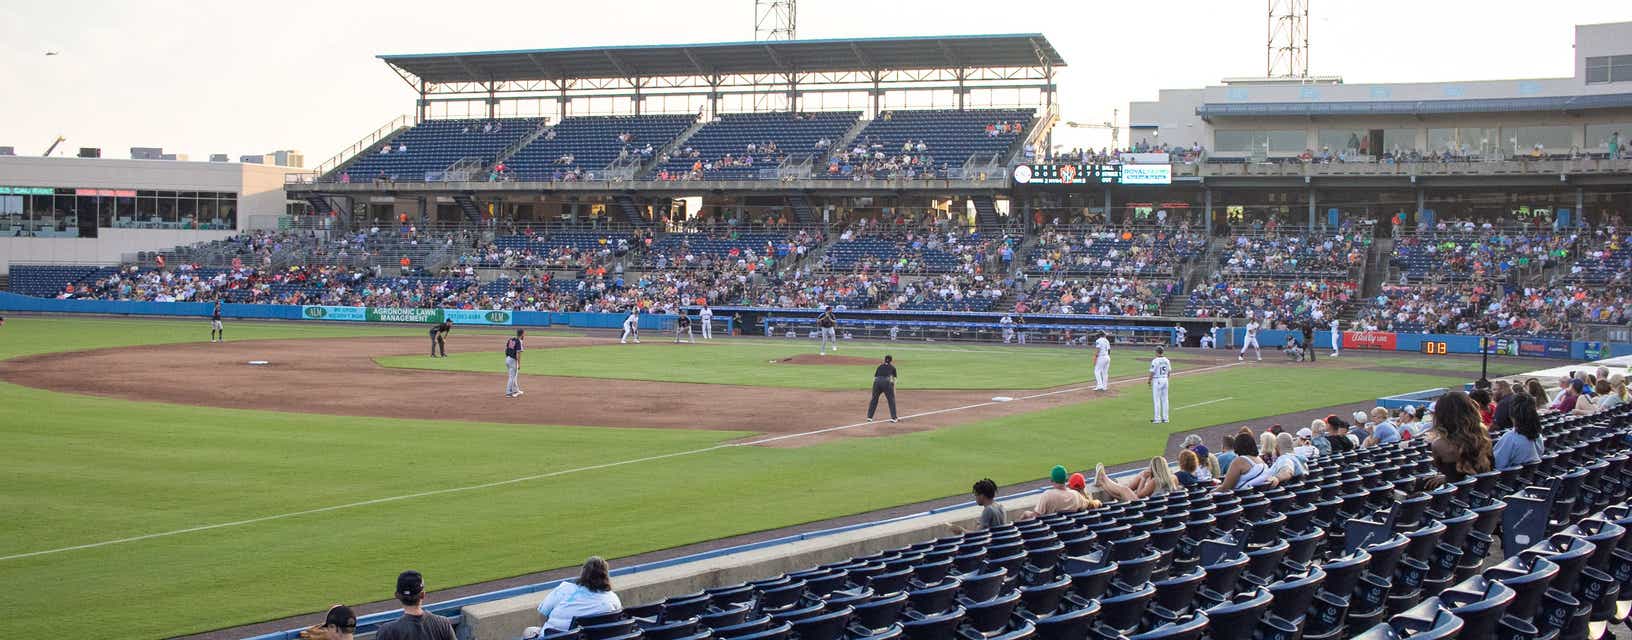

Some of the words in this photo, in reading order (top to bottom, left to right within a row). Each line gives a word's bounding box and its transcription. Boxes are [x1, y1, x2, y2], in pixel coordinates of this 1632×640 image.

[309, 307, 322, 317] ALM
[372, 307, 415, 316] AGRONOMIC
[416, 308, 437, 316] LAWN
[490, 311, 504, 321] ALM
[380, 314, 428, 322] MANAGEMENT
[1159, 366, 1167, 376] 15
